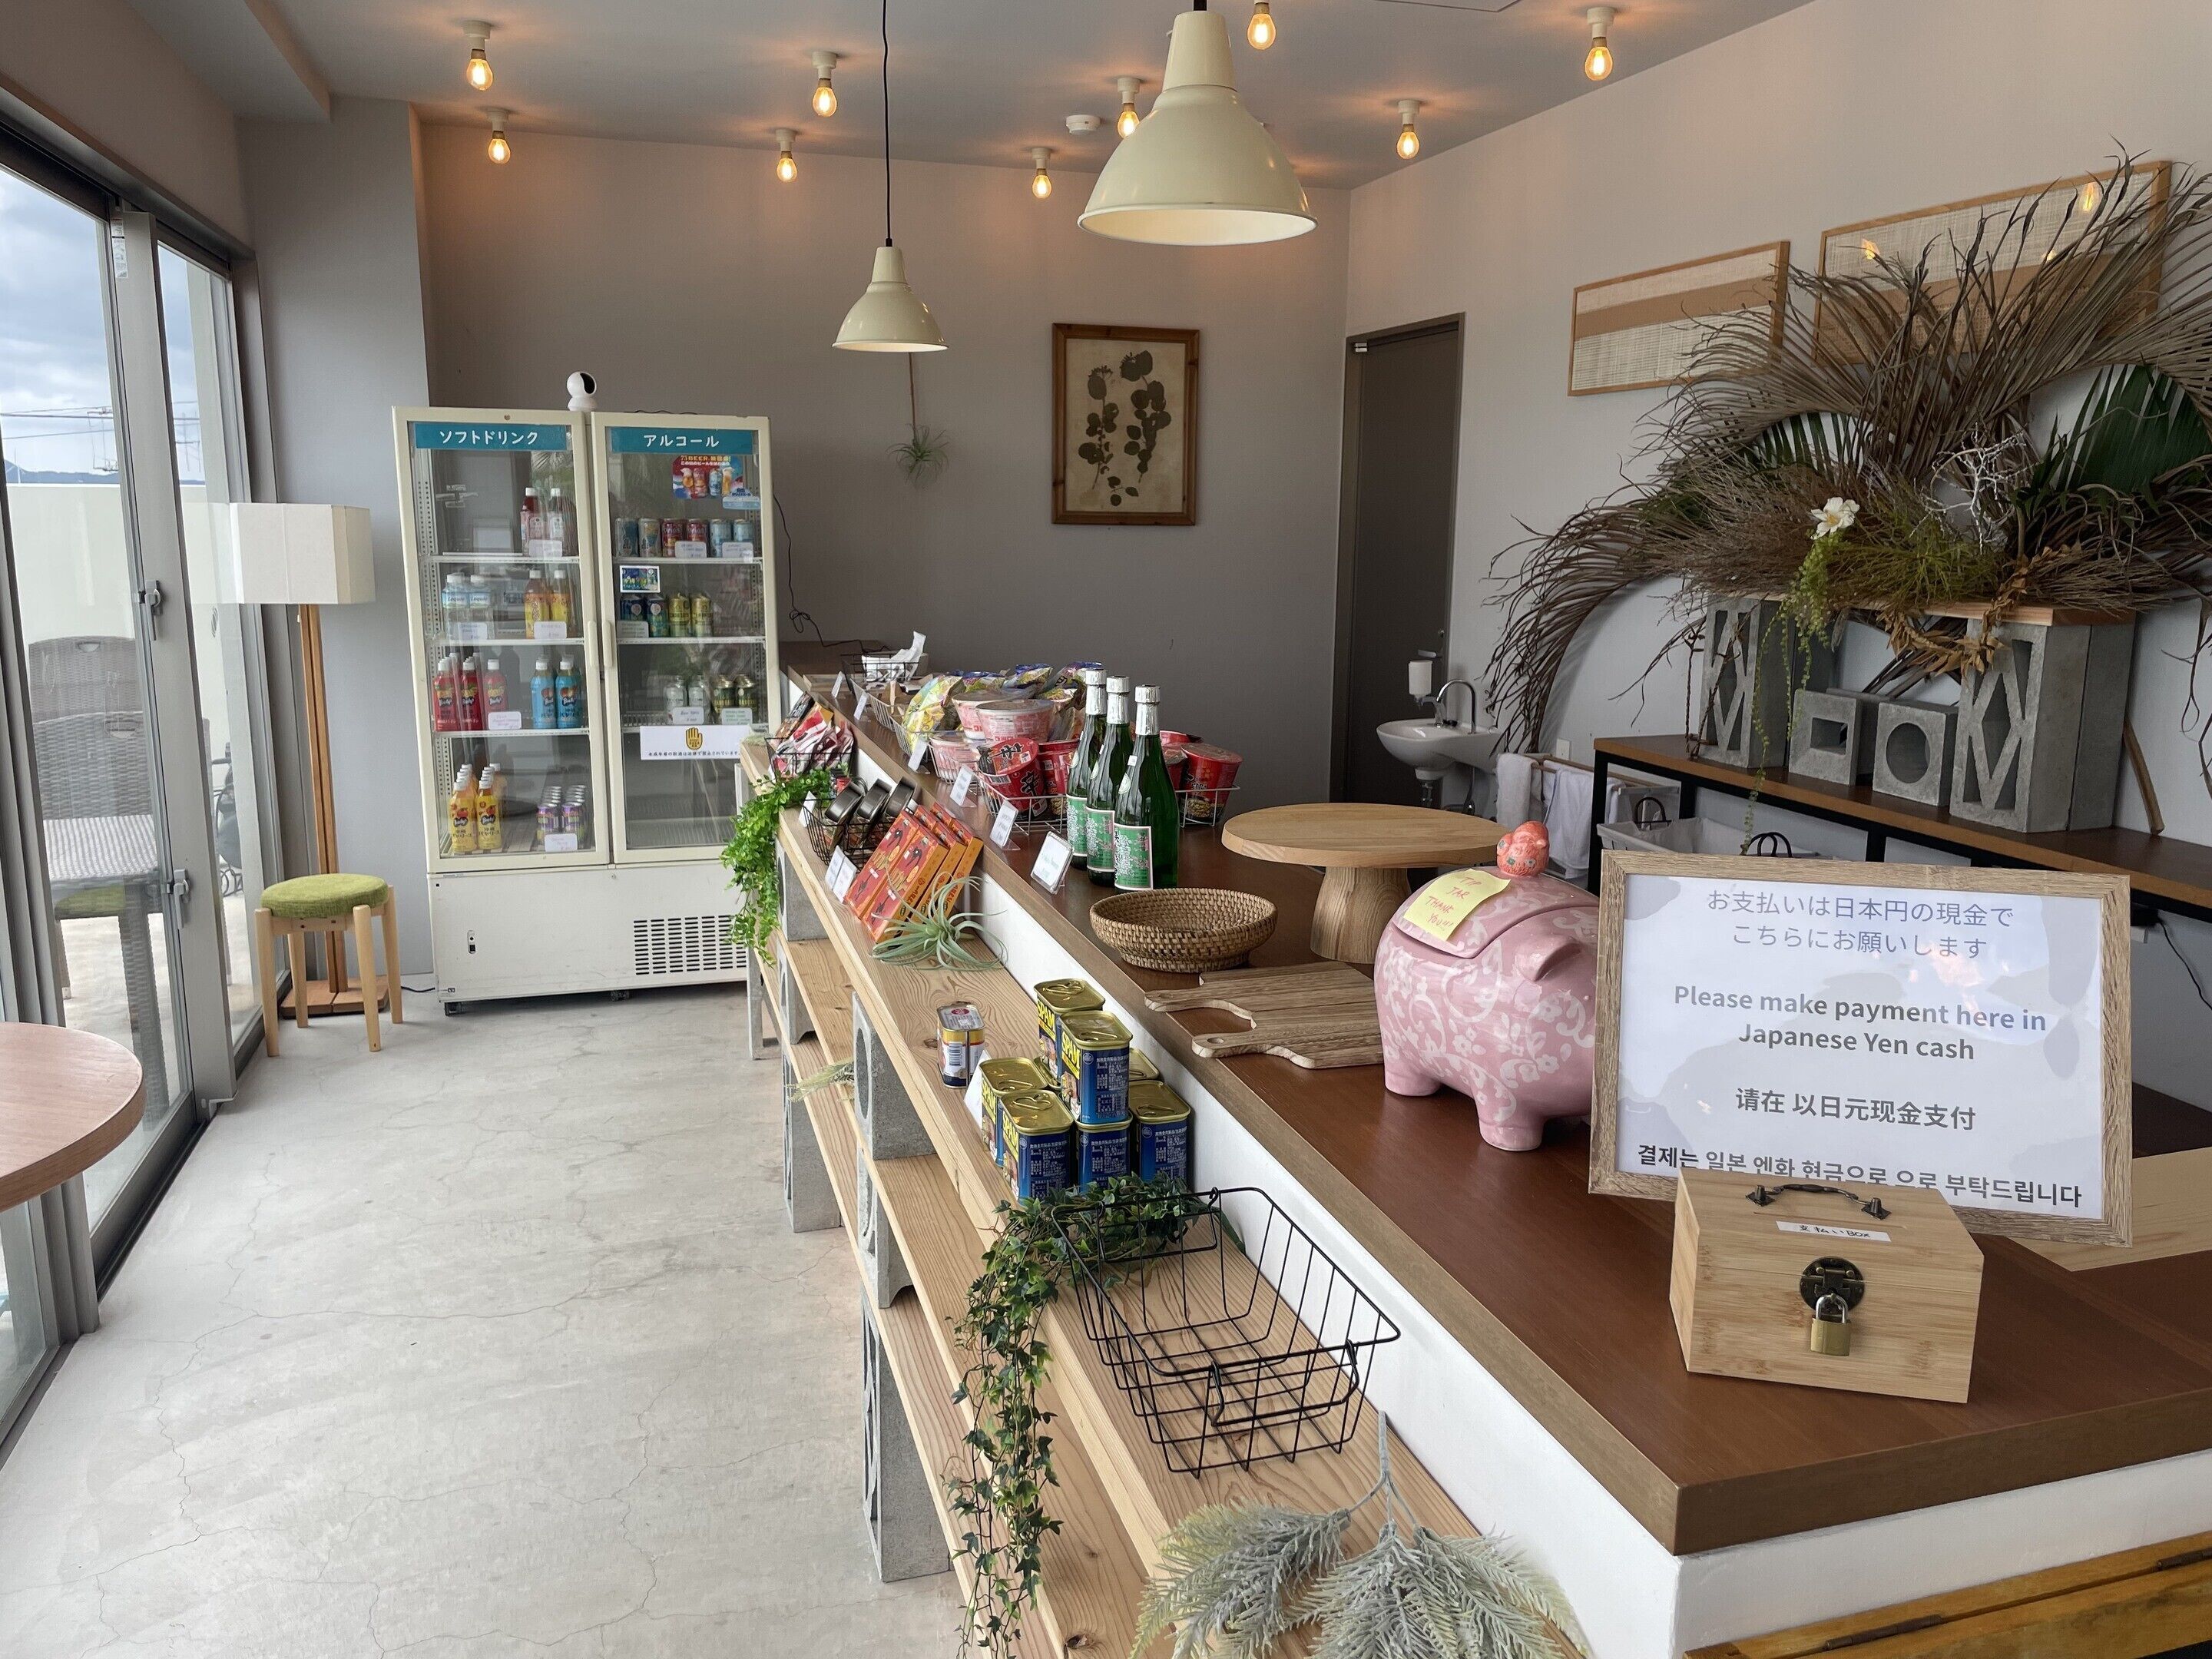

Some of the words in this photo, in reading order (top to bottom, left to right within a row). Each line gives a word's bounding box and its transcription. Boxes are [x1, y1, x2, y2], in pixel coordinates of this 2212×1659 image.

[439, 429, 538, 445] ソフトドリンク
[644, 434, 720, 448] アルコール
[1445, 886, 1470, 899] JAR
[1460, 876, 1482, 886] TIP
[1425, 896, 1455, 914] THANK
[1707, 889, 2015, 927] お支払いは日本円の現金で
[1733, 925, 1988, 959] こちらにお願いします
[1037, 999, 1056, 1034] SPAM
[1674, 985, 1753, 1008] Please
[1760, 993, 1827, 1015] make
[1835, 999, 1949, 1024] payment
[1956, 1005, 2015, 1028] here
[2022, 1009, 2046, 1031] in
[1061, 1031, 1081, 1071] SPAM
[1738, 1023, 1857, 1050] Japanese
[1864, 1032, 1909, 1055] Yen
[1916, 1038, 1975, 1060] cash
[1735, 1087, 1786, 1114] 请在
[1792, 1093, 1976, 1131] 以日元现金支付
[1002, 1109, 1019, 1152] SPAM
[1637, 1144, 1699, 1168] 결제는
[1945, 1174, 2082, 1208] 부탁드립니다
